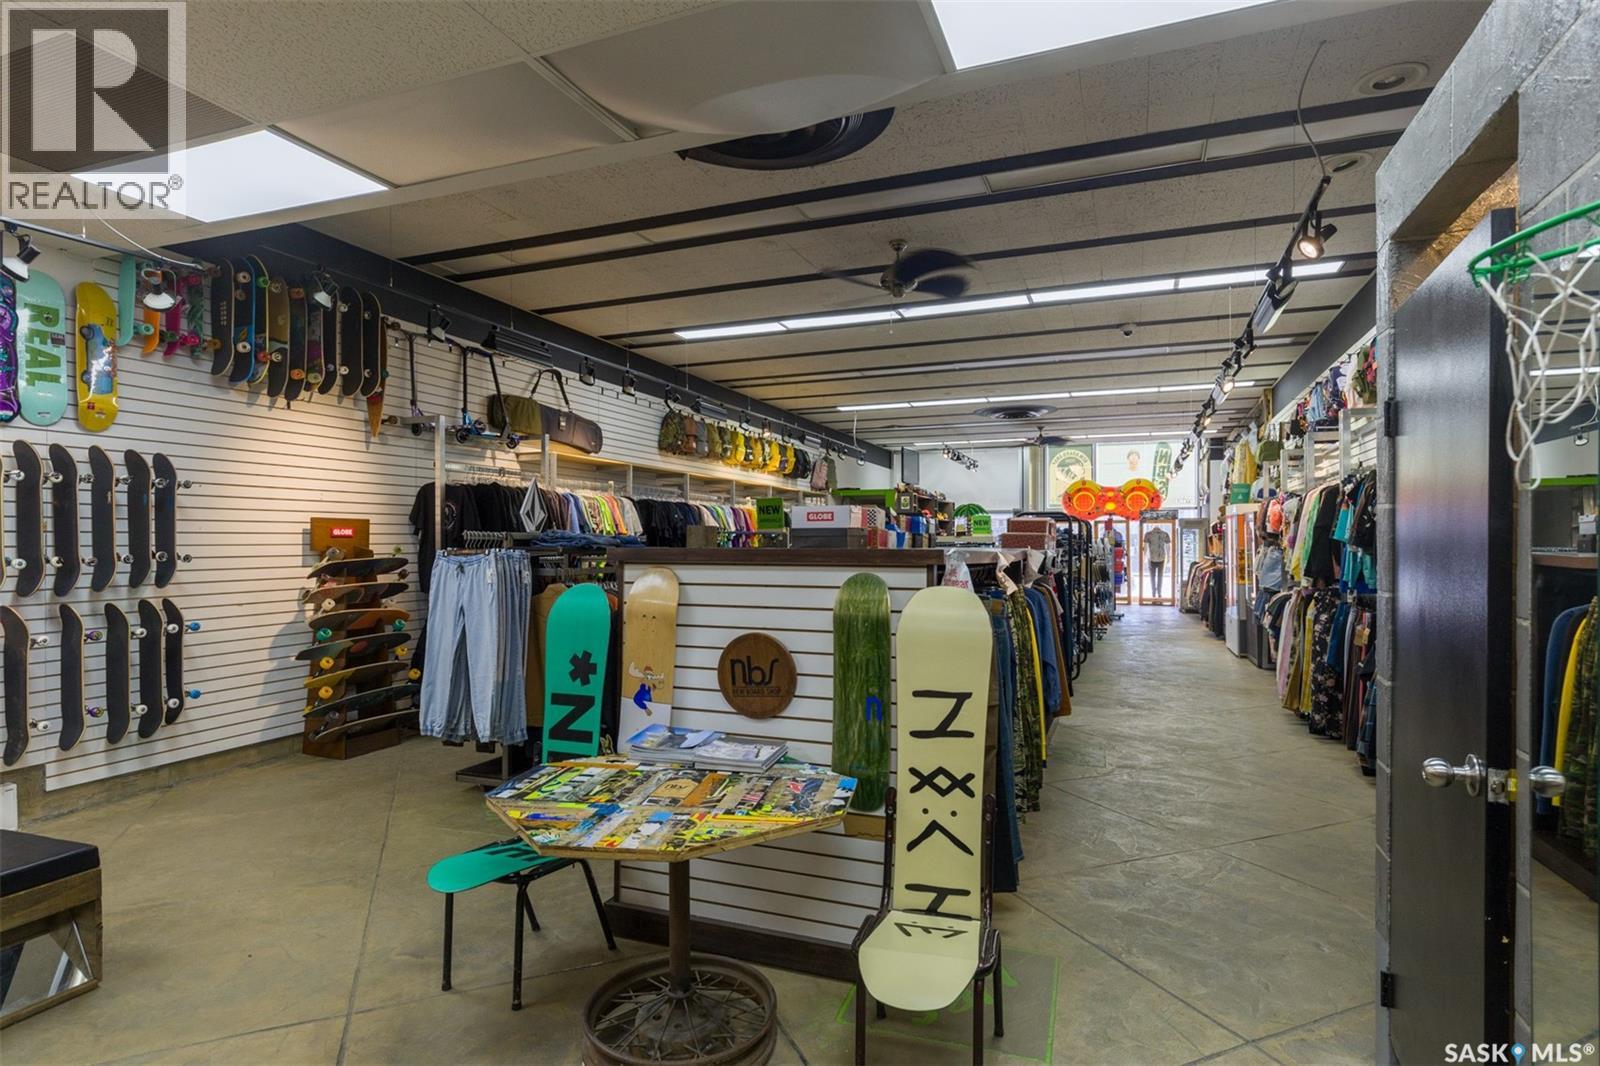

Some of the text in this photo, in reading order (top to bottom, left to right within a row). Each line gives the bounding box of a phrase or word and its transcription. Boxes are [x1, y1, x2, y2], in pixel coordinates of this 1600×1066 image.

[23, 302, 62, 387] REAL
[760, 506, 780, 516] NEW
[807, 512, 833, 521] GLOBE
[332, 528, 353, 536] GLOBE
